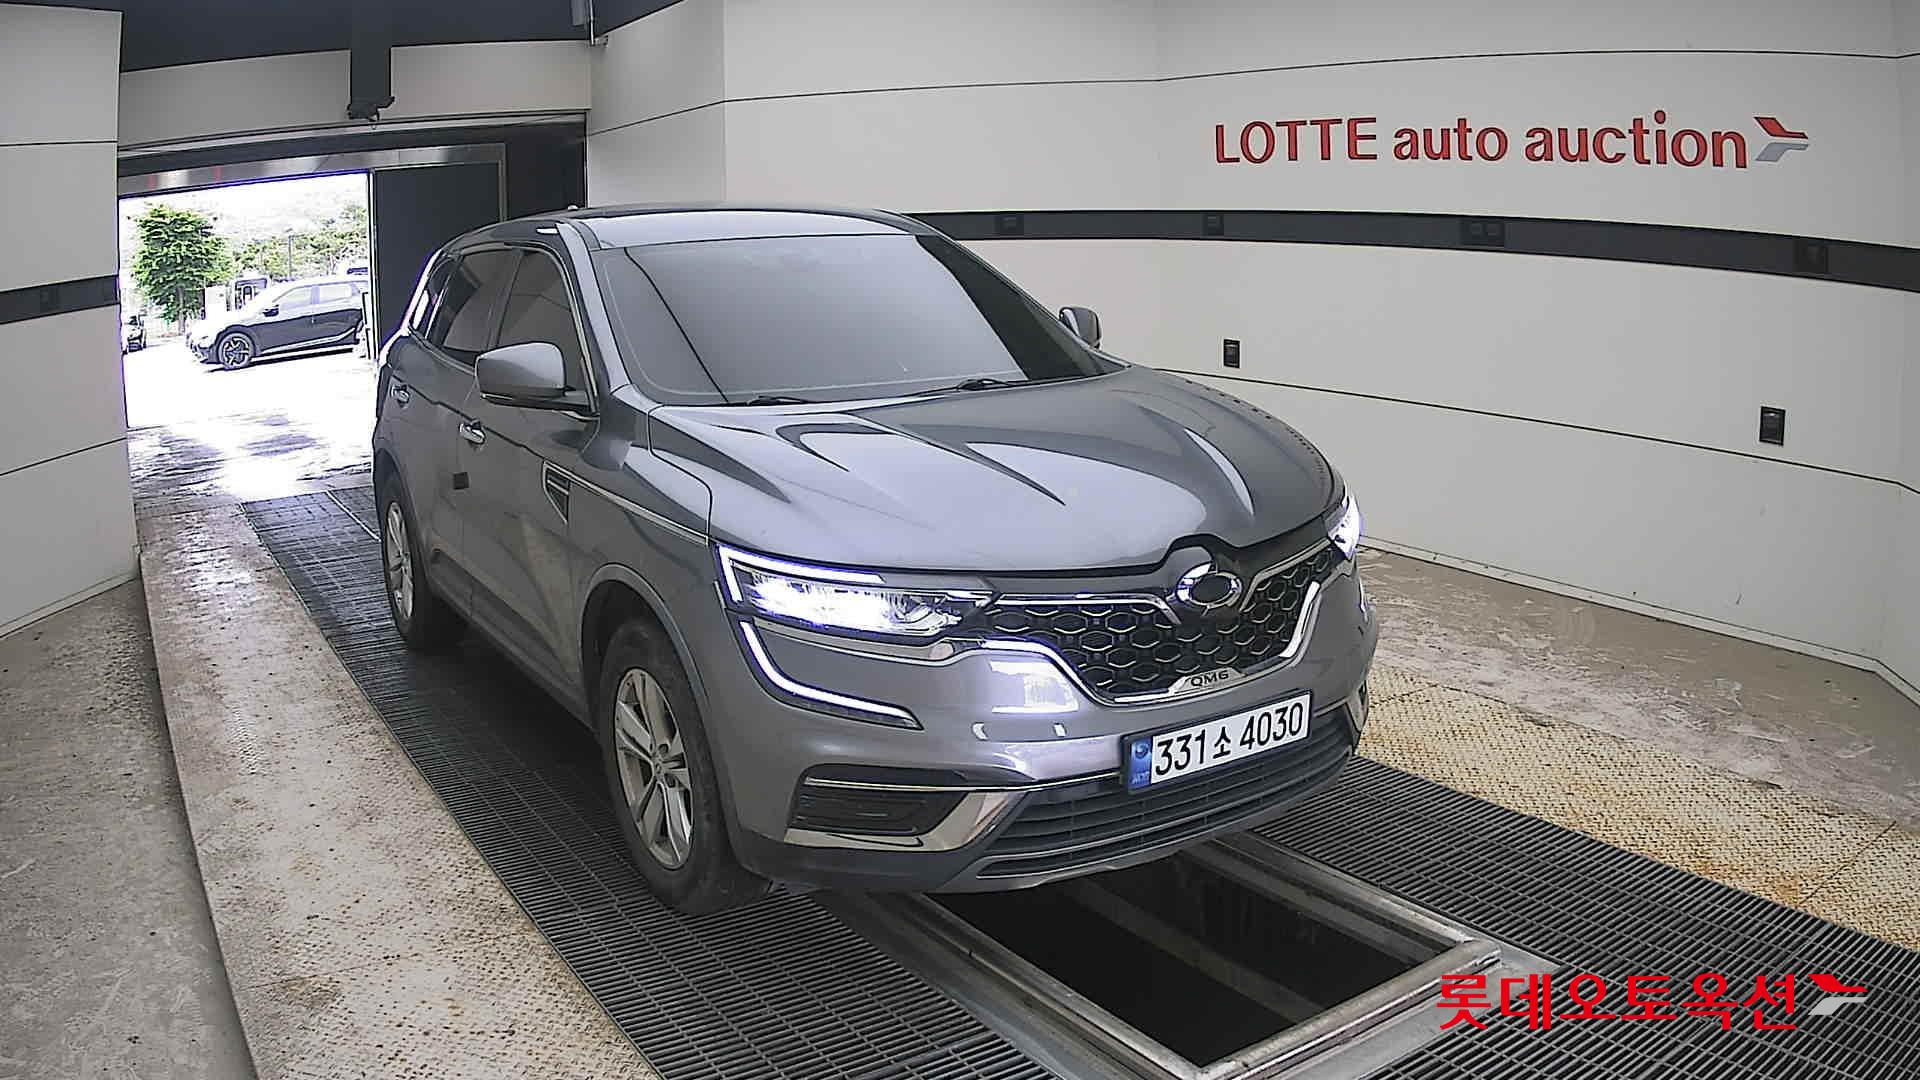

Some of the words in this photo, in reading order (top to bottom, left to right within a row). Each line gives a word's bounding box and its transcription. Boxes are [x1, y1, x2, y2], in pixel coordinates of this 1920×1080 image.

[1215, 117, 1377, 164] LOTTE
[1393, 117, 1509, 162] auto
[1524, 110, 1749, 169] auction
[1239, 702, 1304, 750] 4030
